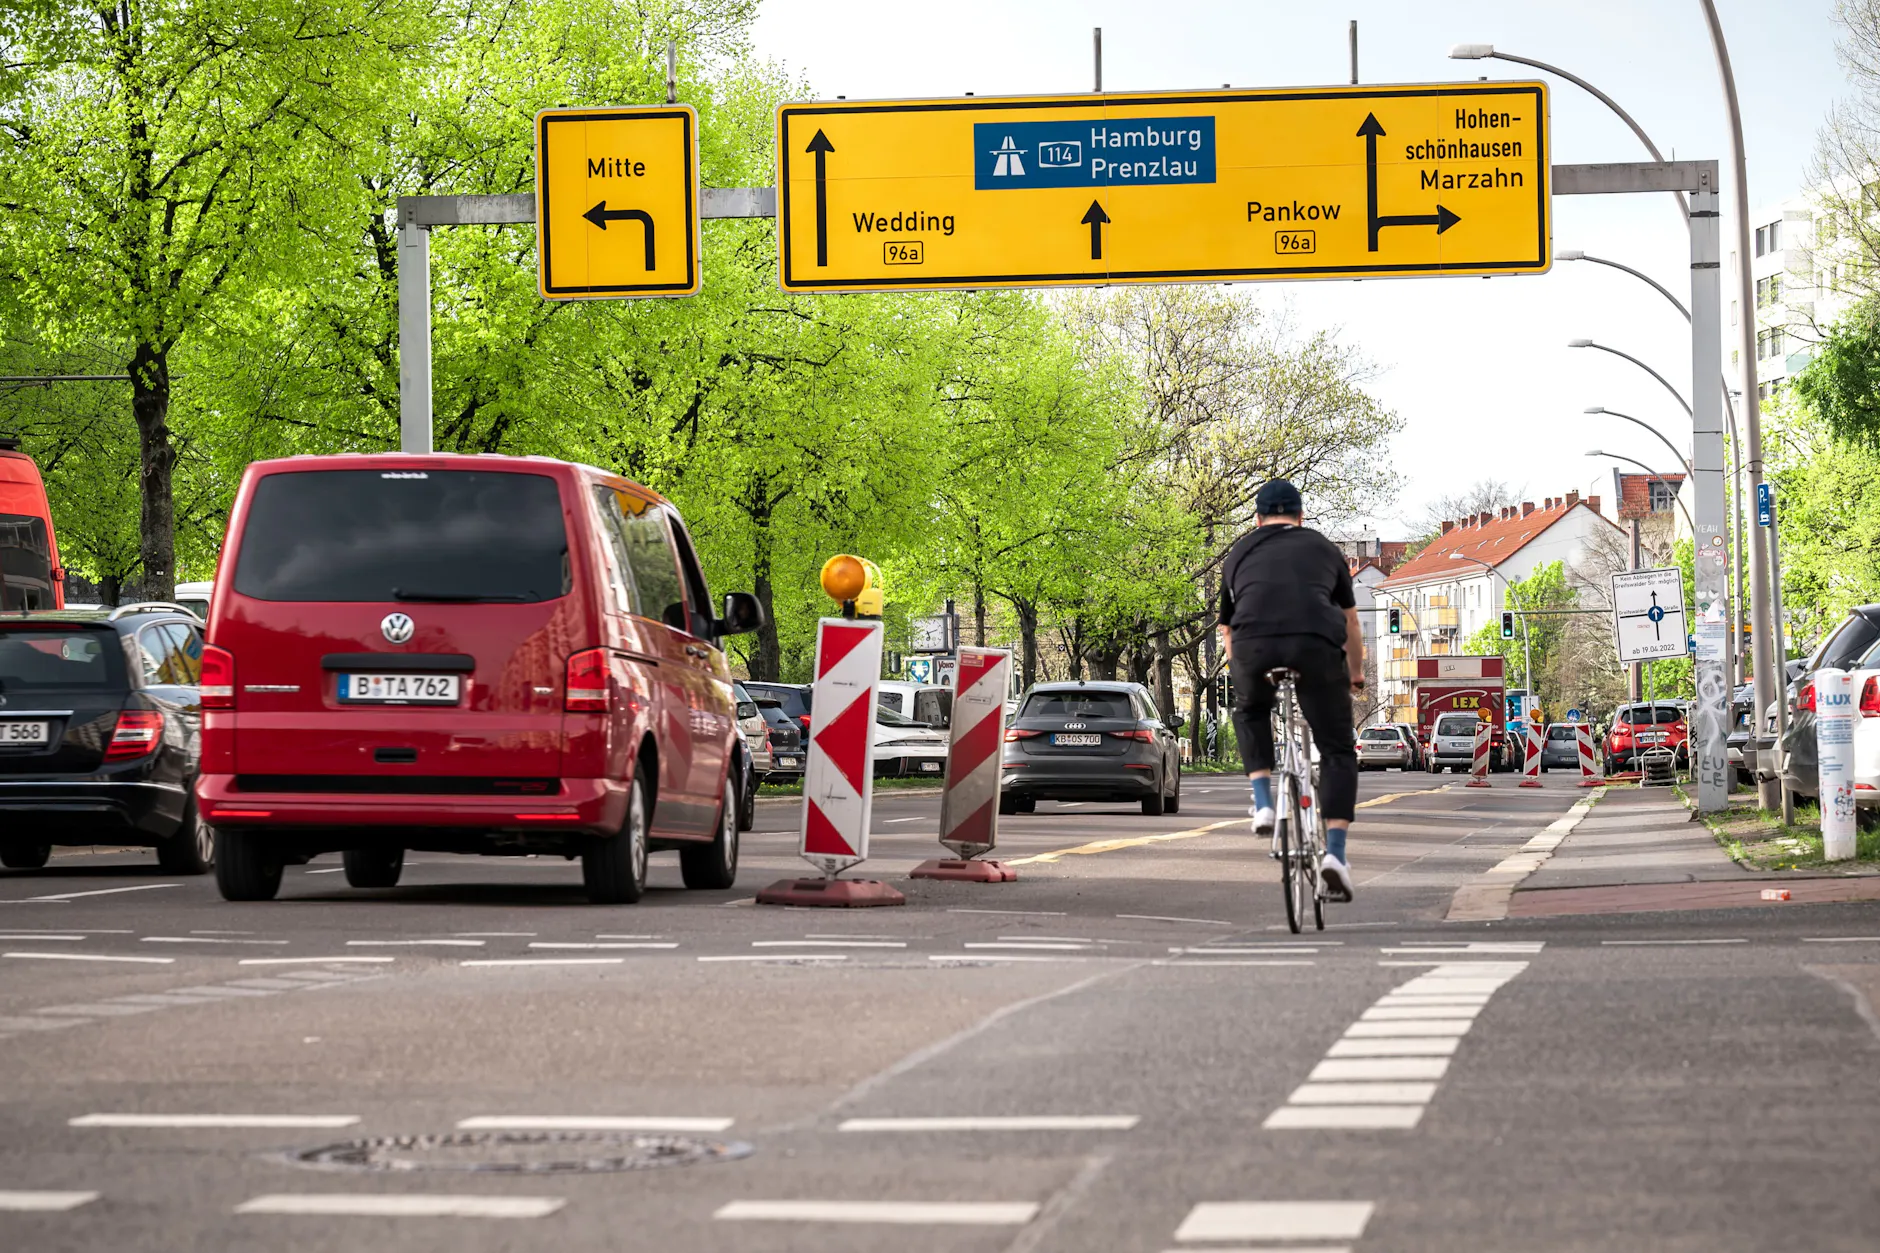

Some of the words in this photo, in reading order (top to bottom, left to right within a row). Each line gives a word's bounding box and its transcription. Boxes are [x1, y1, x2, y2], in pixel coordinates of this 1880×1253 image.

[1455, 107, 1522, 130] Hohen-
[1091, 125, 1201, 151] Hamburg
[1047, 146, 1072, 162] 114
[1405, 138, 1522, 160] schönhausen
[587, 157, 646, 179] Mitte
[1091, 156, 1197, 179] Prenzlau
[1420, 167, 1523, 190] Marzahn
[1247, 200, 1341, 222] Pankow
[852, 210, 955, 236] Wedding
[1281, 234, 1310, 250] 96a
[889, 245, 918, 261] 96a
[1696, 524, 1718, 533] YEAH
[1614, 580, 1647, 589] Greifswalder
[1658, 578, 1679, 586] möglich
[1633, 573, 1657, 581] Abbiegen
[1642, 643, 1675, 654] 19.04.2022
[358, 677, 370, 697] B
[413, 677, 450, 697] 762
[1452, 696, 1480, 709] LEX
[10, 724, 41, 740] 568
[1055, 734, 1067, 744] KB
[1084, 734, 1100, 744] 700
